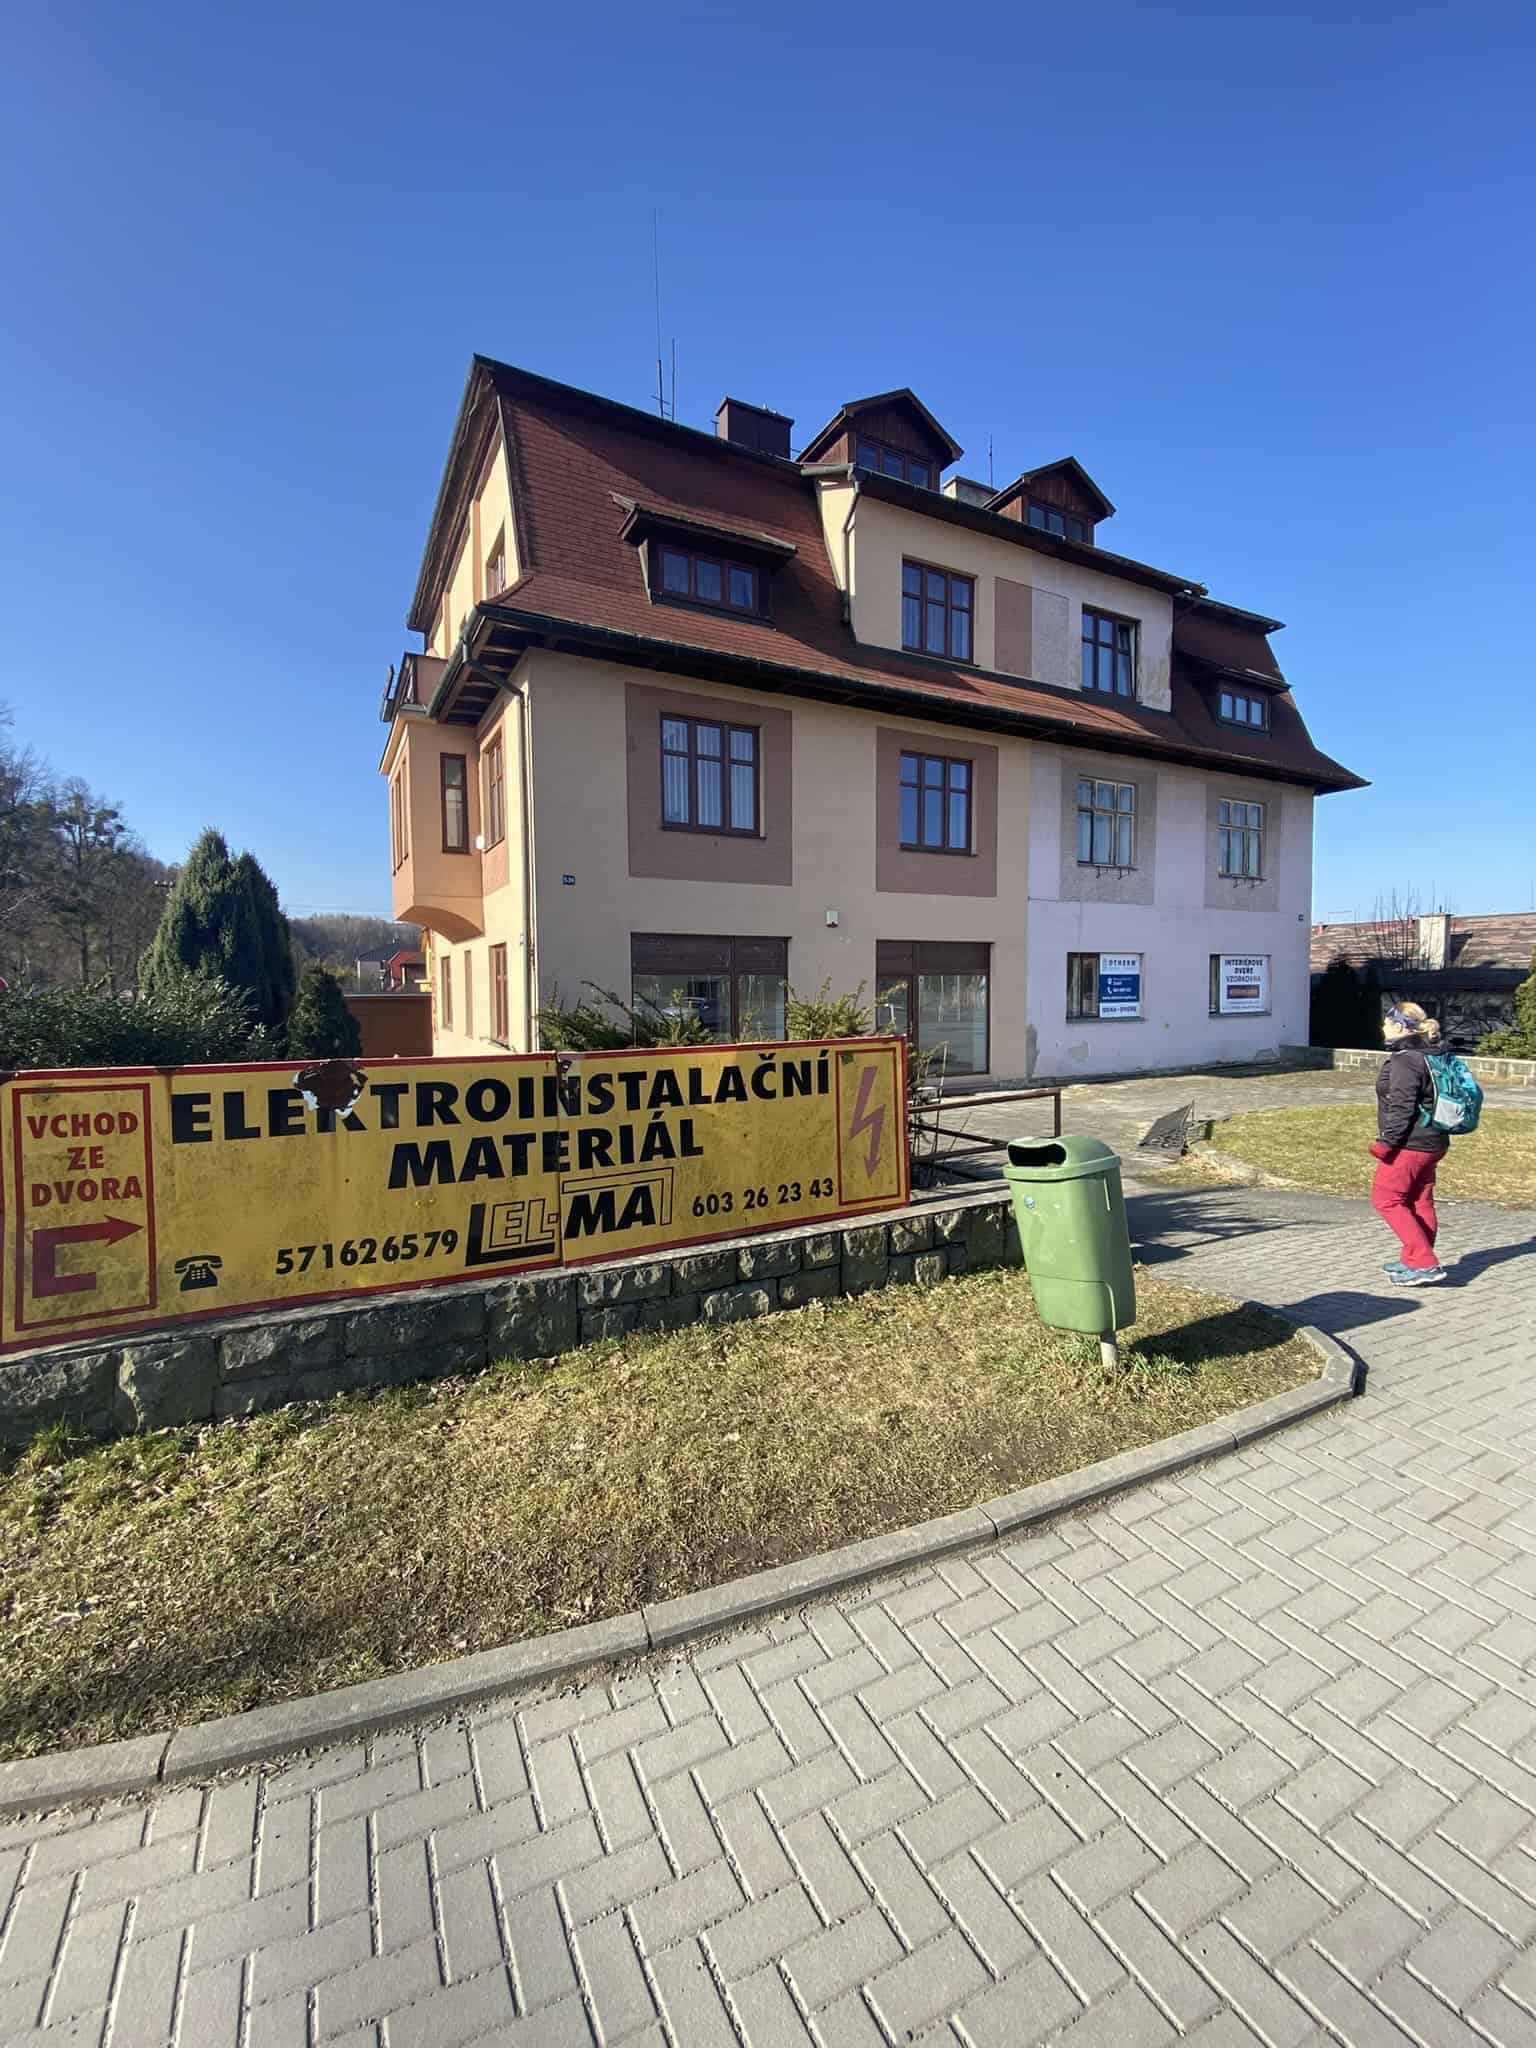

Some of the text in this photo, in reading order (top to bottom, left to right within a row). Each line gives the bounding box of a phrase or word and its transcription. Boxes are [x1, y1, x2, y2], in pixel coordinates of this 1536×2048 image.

[27, 1111, 139, 1139] VCHOD
[67, 1146, 105, 1171] ZE
[388, 1108, 704, 1189] MATERIÁL
[31, 1175, 144, 1207] DVORA
[692, 1177, 834, 1217] 603 26 23 43
[275, 1229, 458, 1275] 571626579
